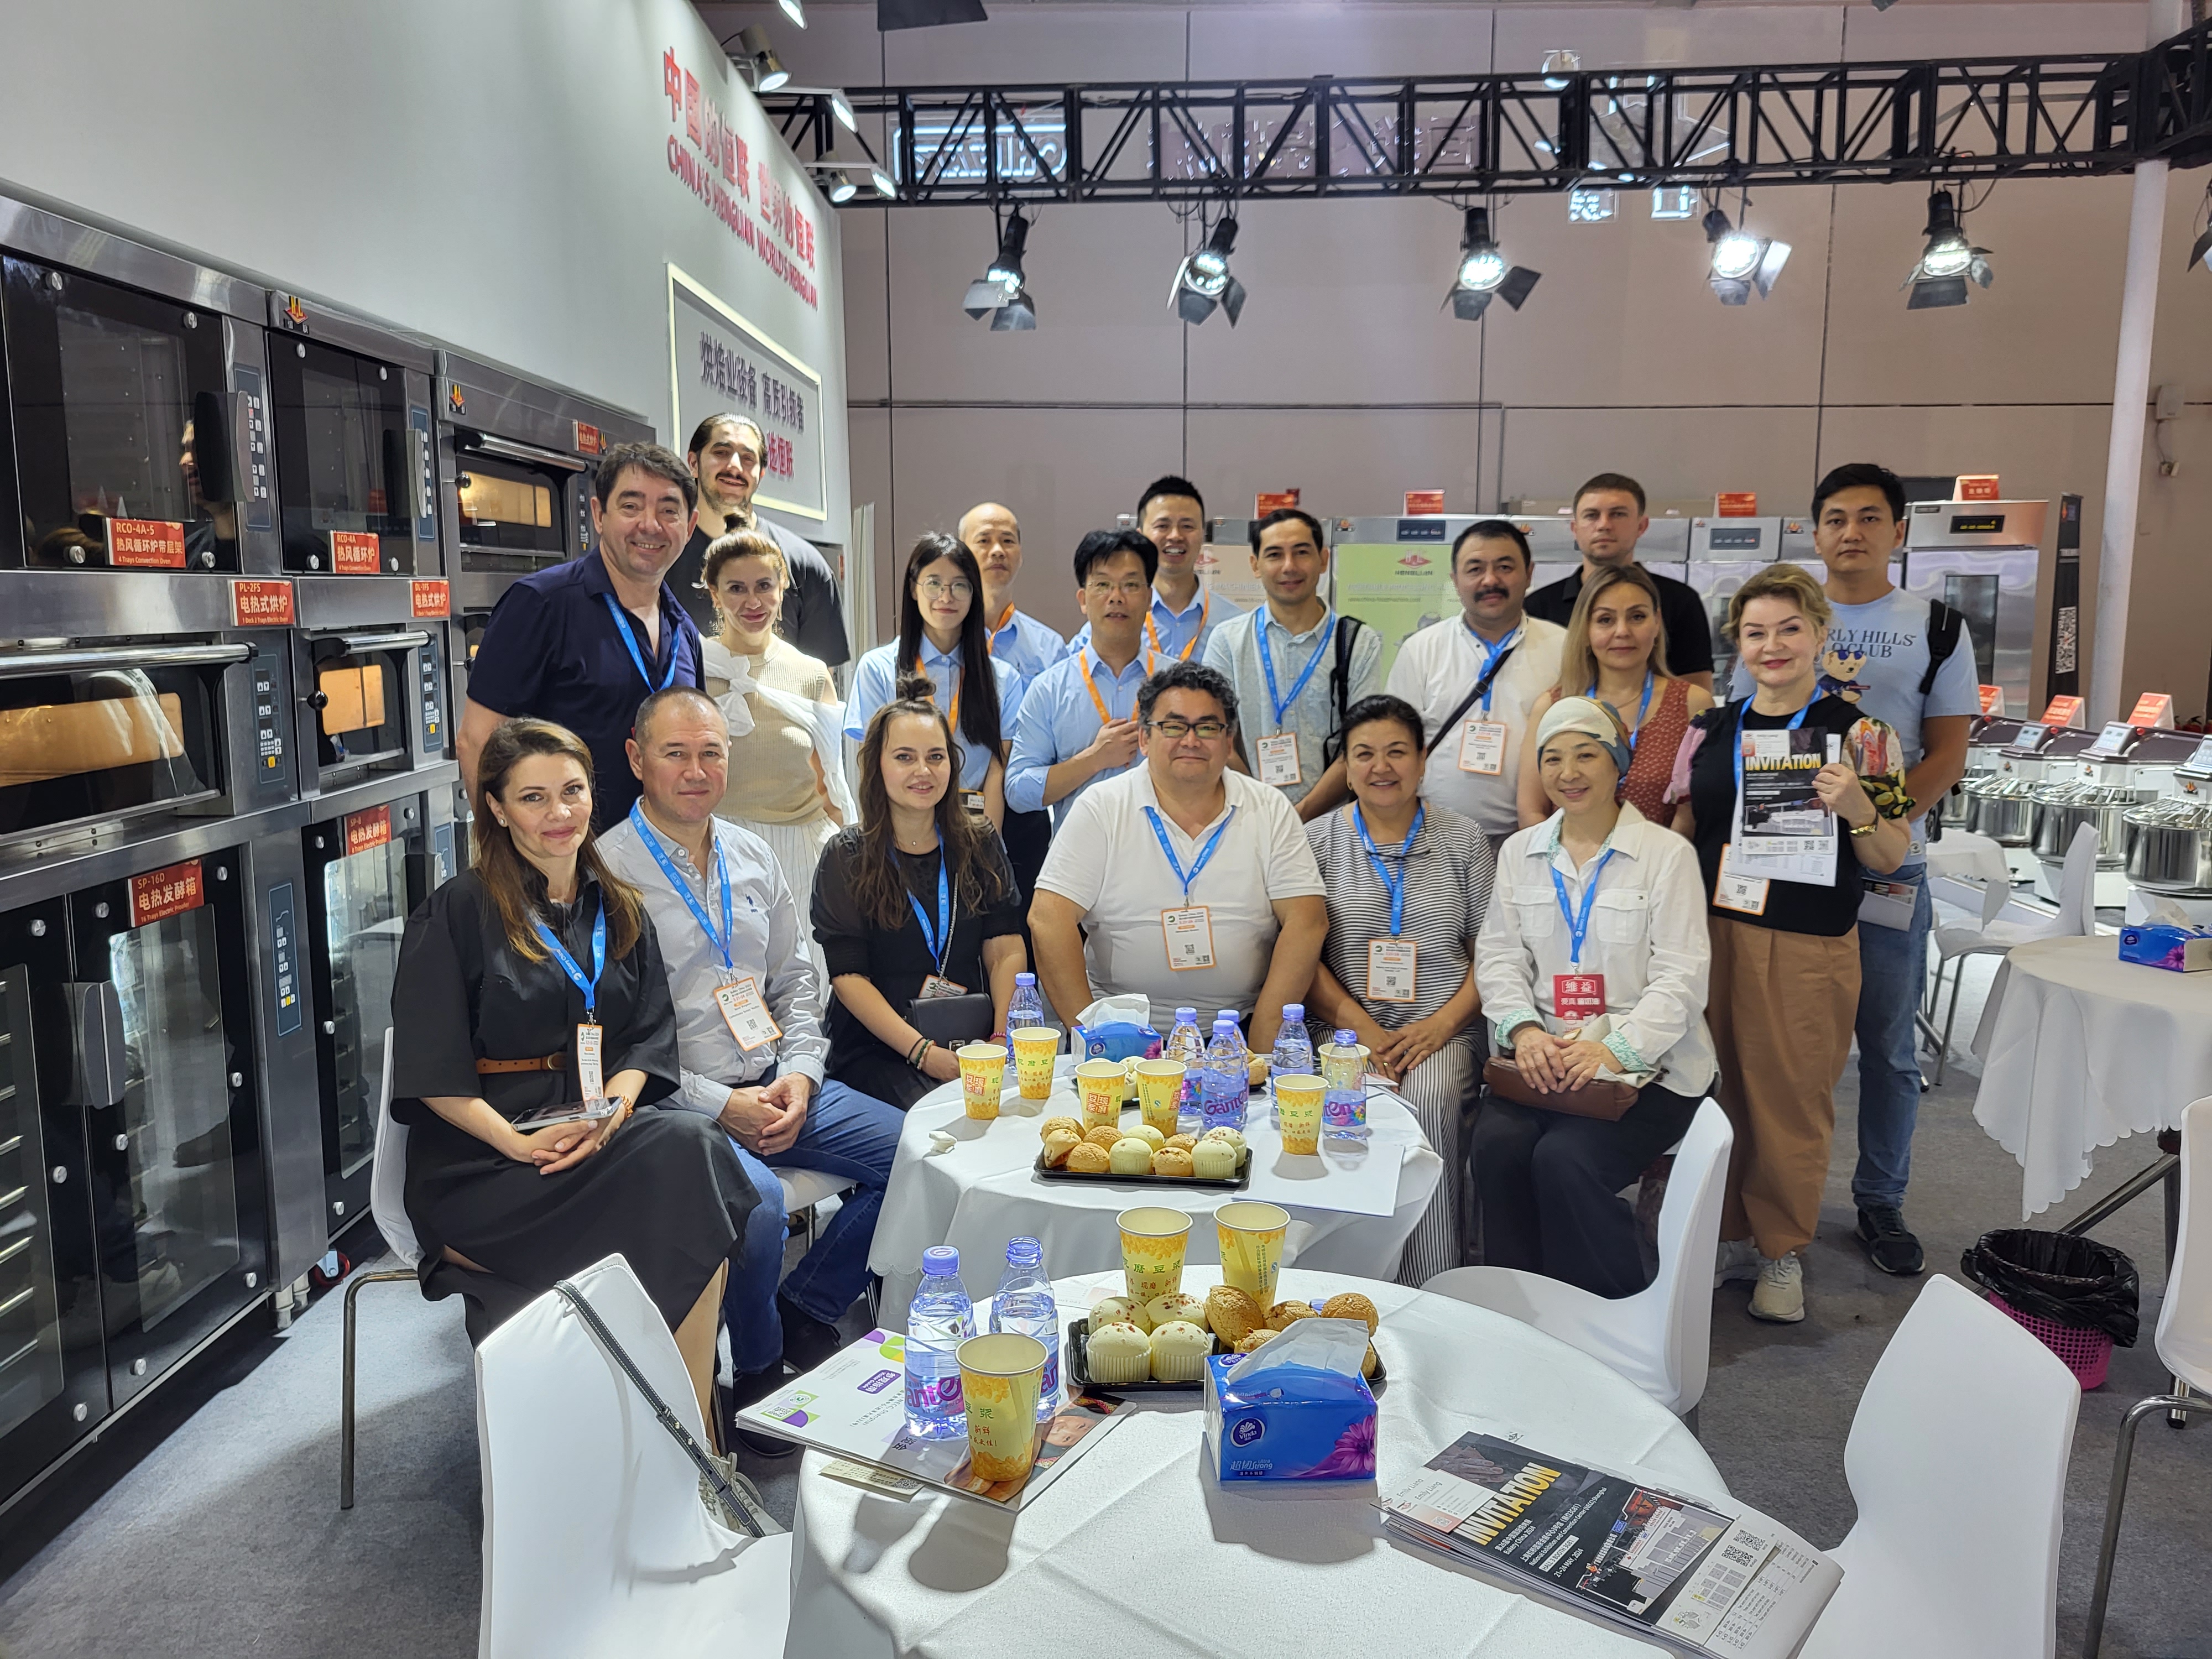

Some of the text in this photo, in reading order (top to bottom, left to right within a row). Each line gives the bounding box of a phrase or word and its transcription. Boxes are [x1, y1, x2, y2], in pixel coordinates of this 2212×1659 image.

[117, 537, 182, 554] 热风循环炉带层架
[337, 545, 375, 562] 热风循环炉
[240, 594, 288, 614] 电热式烘炉
[1861, 630, 1916, 646] HILLS
[1745, 753, 1822, 771] INVITATION
[351, 820, 387, 844] 电热发酵箱
[138, 873, 165, 889] SP-16D
[139, 876, 196, 911] 电热发酵箱
[147, 912, 159, 921] Trays
[159, 907, 174, 917] Electric
[565, 959, 576, 974] Bakery
[862, 1371, 886, 1389] Visitor Guide
[865, 1372, 896, 1394] 参观指南
[974, 1424, 991, 1435] 新鲜
[1239, 1430, 1257, 1440] Vinda
[1230, 1460, 1253, 1470] 超韧
[1252, 1461, 1273, 1470] Strong
[1415, 1480, 1442, 1501] Emily Liang
[1453, 1462, 1562, 1546] INVITATION
[1529, 1552, 1545, 1566] National
[1541, 1538, 1558, 1554] Exhibition
[1560, 1517, 1578, 1535] Convention
[1575, 1509, 1587, 1520] Center
[1592, 1486, 1608, 1501] Shanghai
[1503, 1525, 1536, 1555] Bakery China 2024
[1541, 1559, 1553, 1571] HALL
[1552, 1546, 1567, 1560] BOOTH
[1553, 1564, 1568, 1578] 21-24
